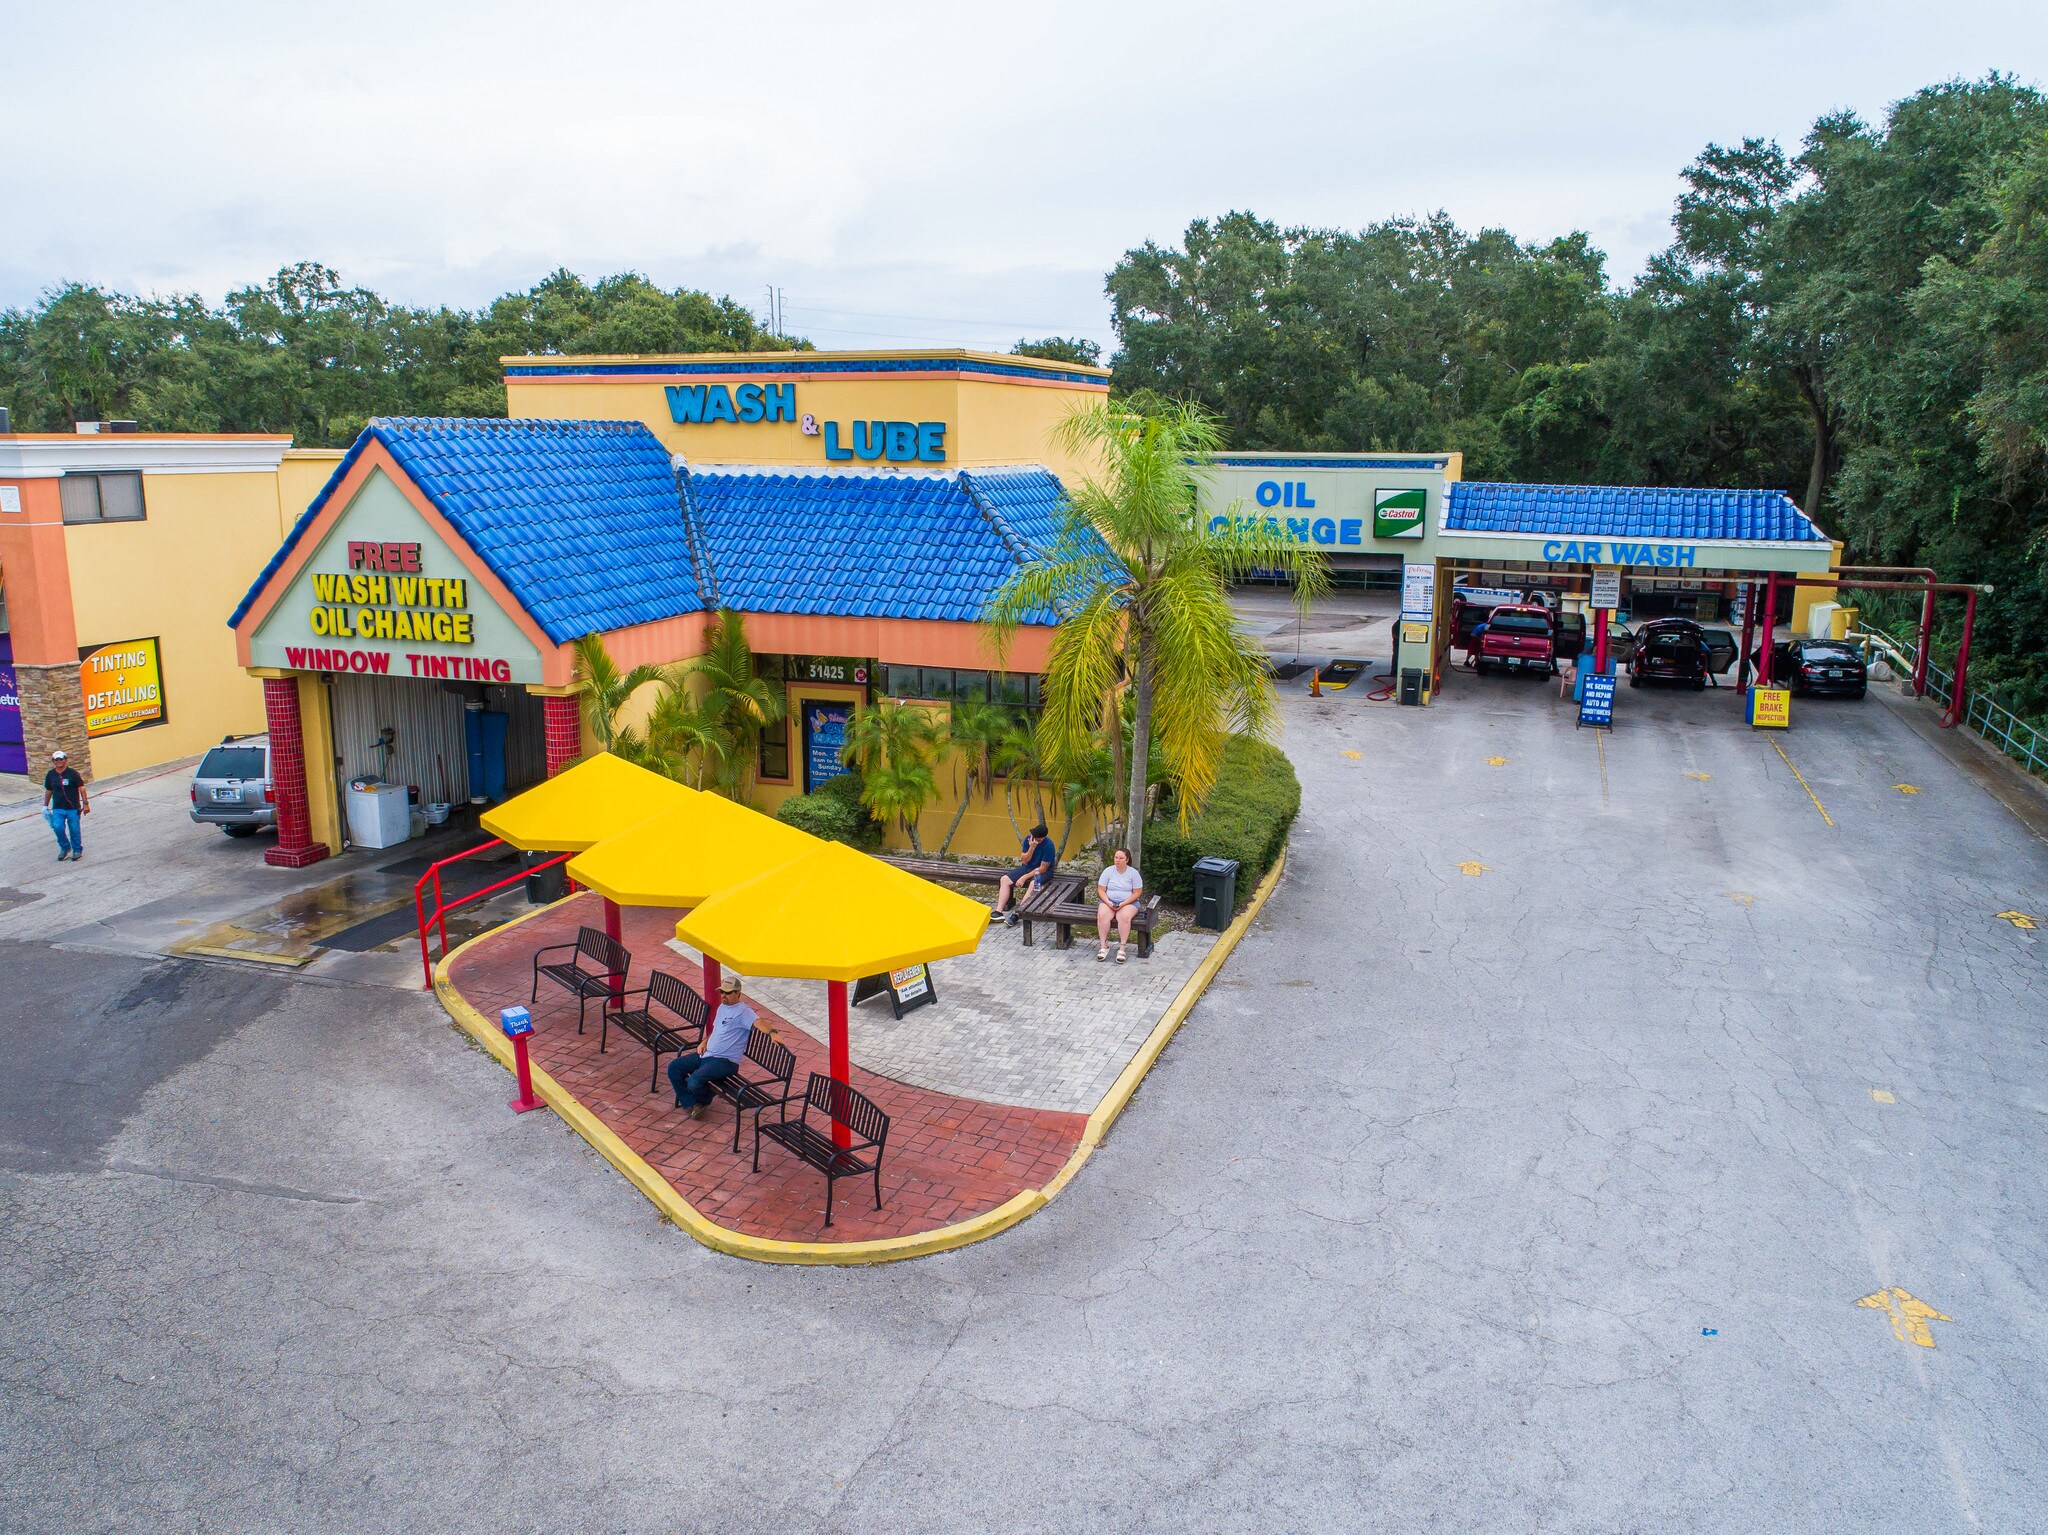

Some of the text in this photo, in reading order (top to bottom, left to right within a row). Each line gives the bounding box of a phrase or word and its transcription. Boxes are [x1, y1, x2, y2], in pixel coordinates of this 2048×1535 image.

[664, 383, 946, 462] WASH & LUBE
[1256, 480, 1316, 508] OIL
[1387, 509, 1417, 519] Castrol
[347, 541, 422, 572] FREE
[1543, 540, 1695, 567] CAR WASH
[311, 573, 467, 608] WASH WITH
[310, 606, 474, 644] OIL CHANGE
[91, 650, 147, 673] TINTING
[285, 646, 511, 682] WINDOW TINTING
[118, 673, 124, 685] +
[810, 665, 844, 679] 31425
[1595, 683, 1613, 691] SERVICE
[88, 683, 157, 711] DETAILING
[1595, 691, 1612, 699] REPAIR
[1763, 692, 1781, 701] FREE
[1585, 699, 1600, 707] AUTO
[1760, 703, 1783, 712] BRAKE
[102, 716, 113, 724] CAR
[113, 713, 128, 721] WASH
[130, 707, 158, 718] ATTENDANT
[818, 764, 842, 772] Sunday
[511, 1019, 528, 1027] Thank
[514, 1025, 526, 1034] You!
